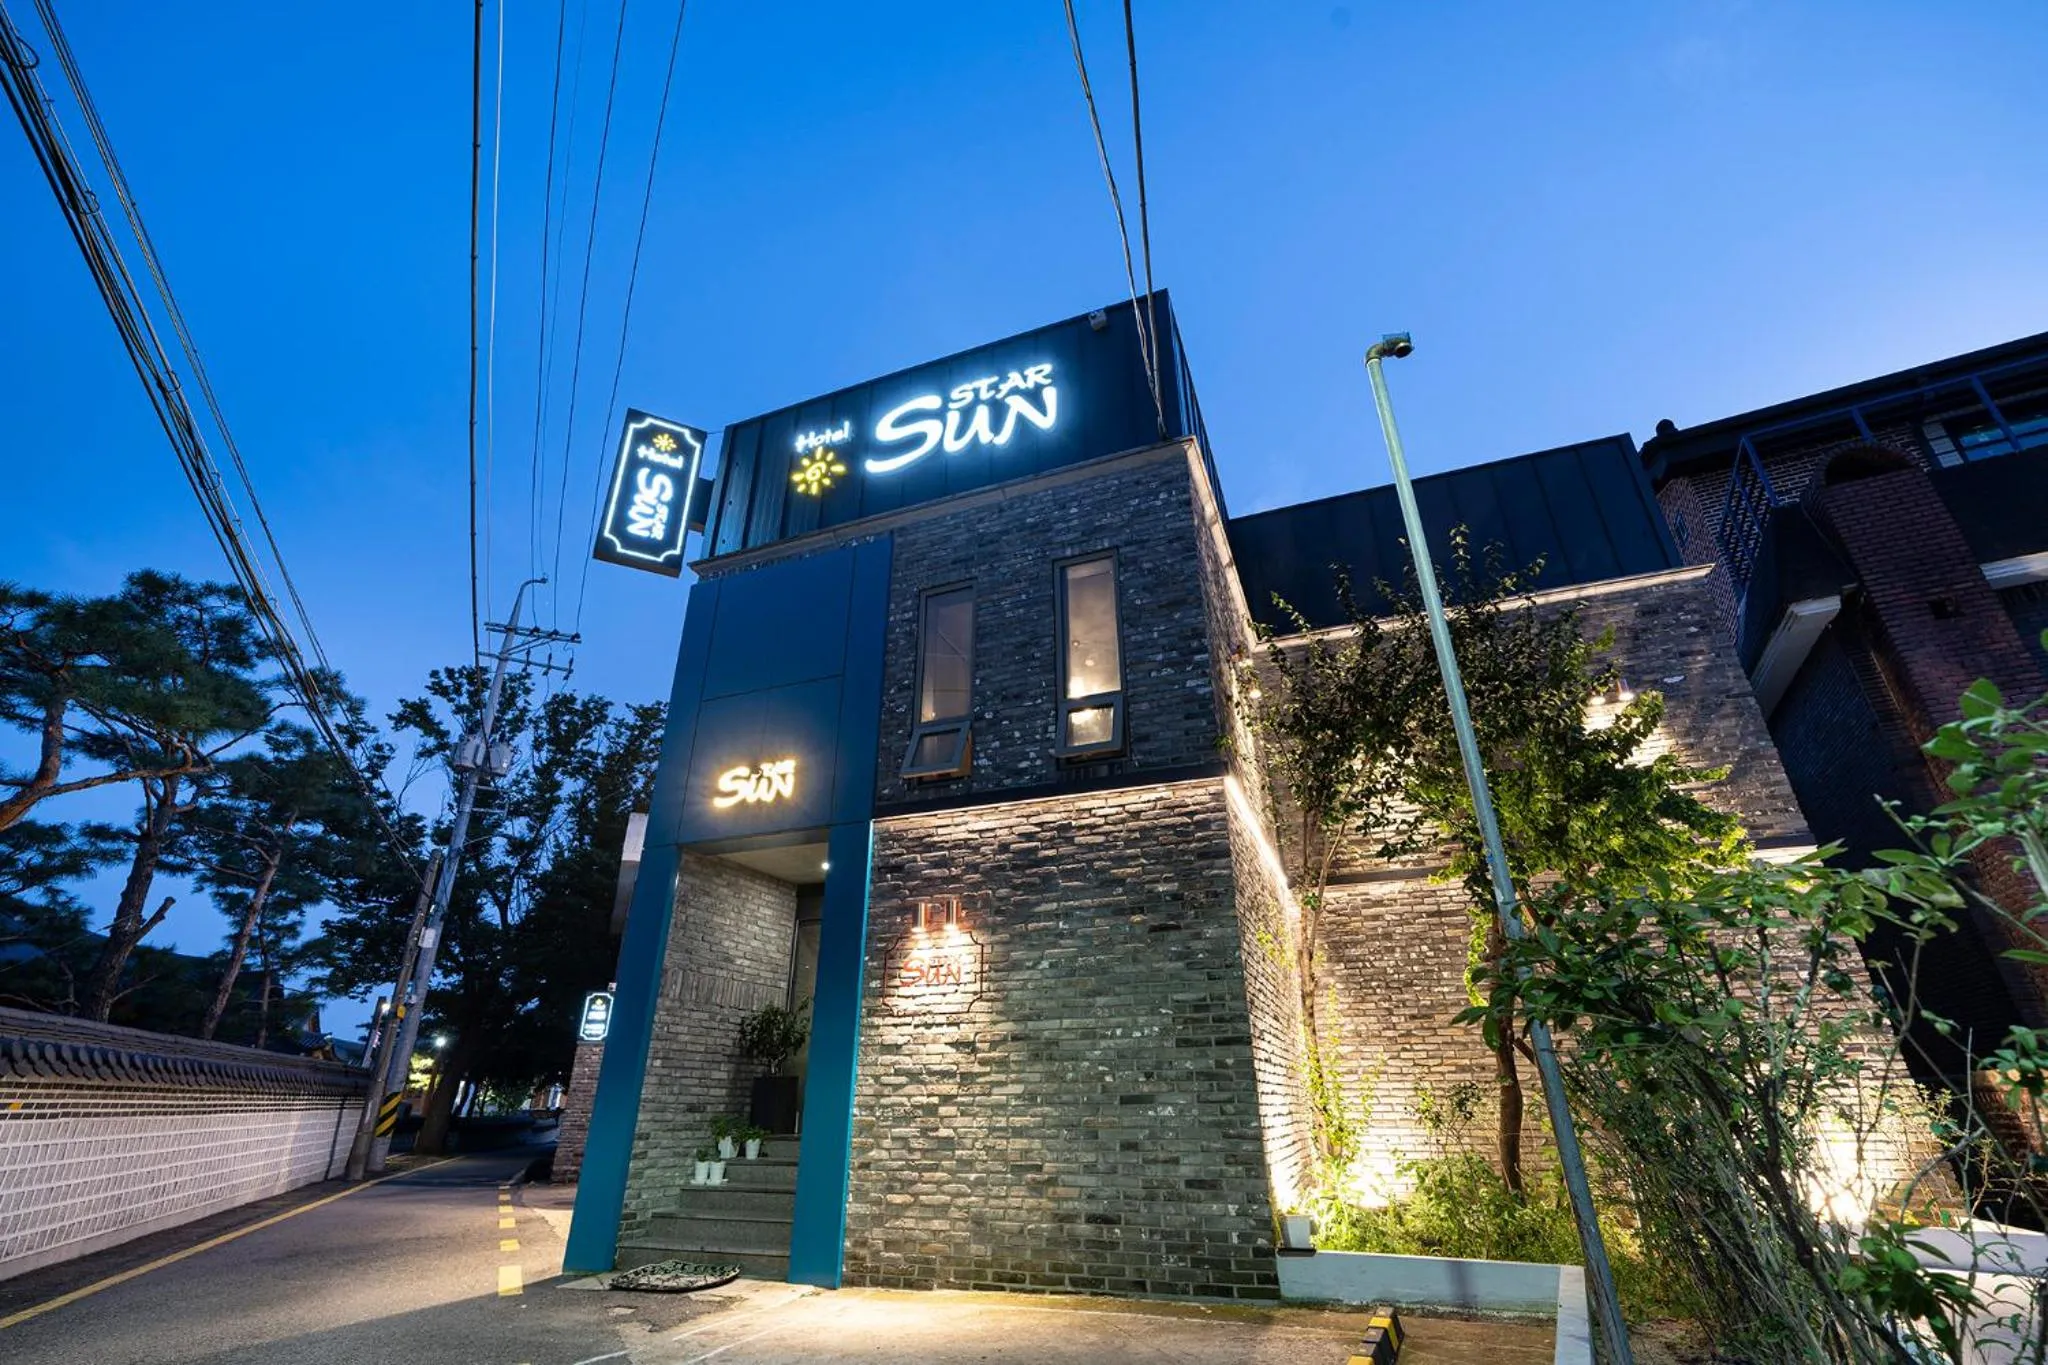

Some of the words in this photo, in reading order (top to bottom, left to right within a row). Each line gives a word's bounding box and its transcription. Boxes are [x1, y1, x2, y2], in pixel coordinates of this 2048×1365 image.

[948, 363, 1052, 409] STAR
[795, 420, 850, 453] Hotel
[865, 386, 1057, 474] SUN
